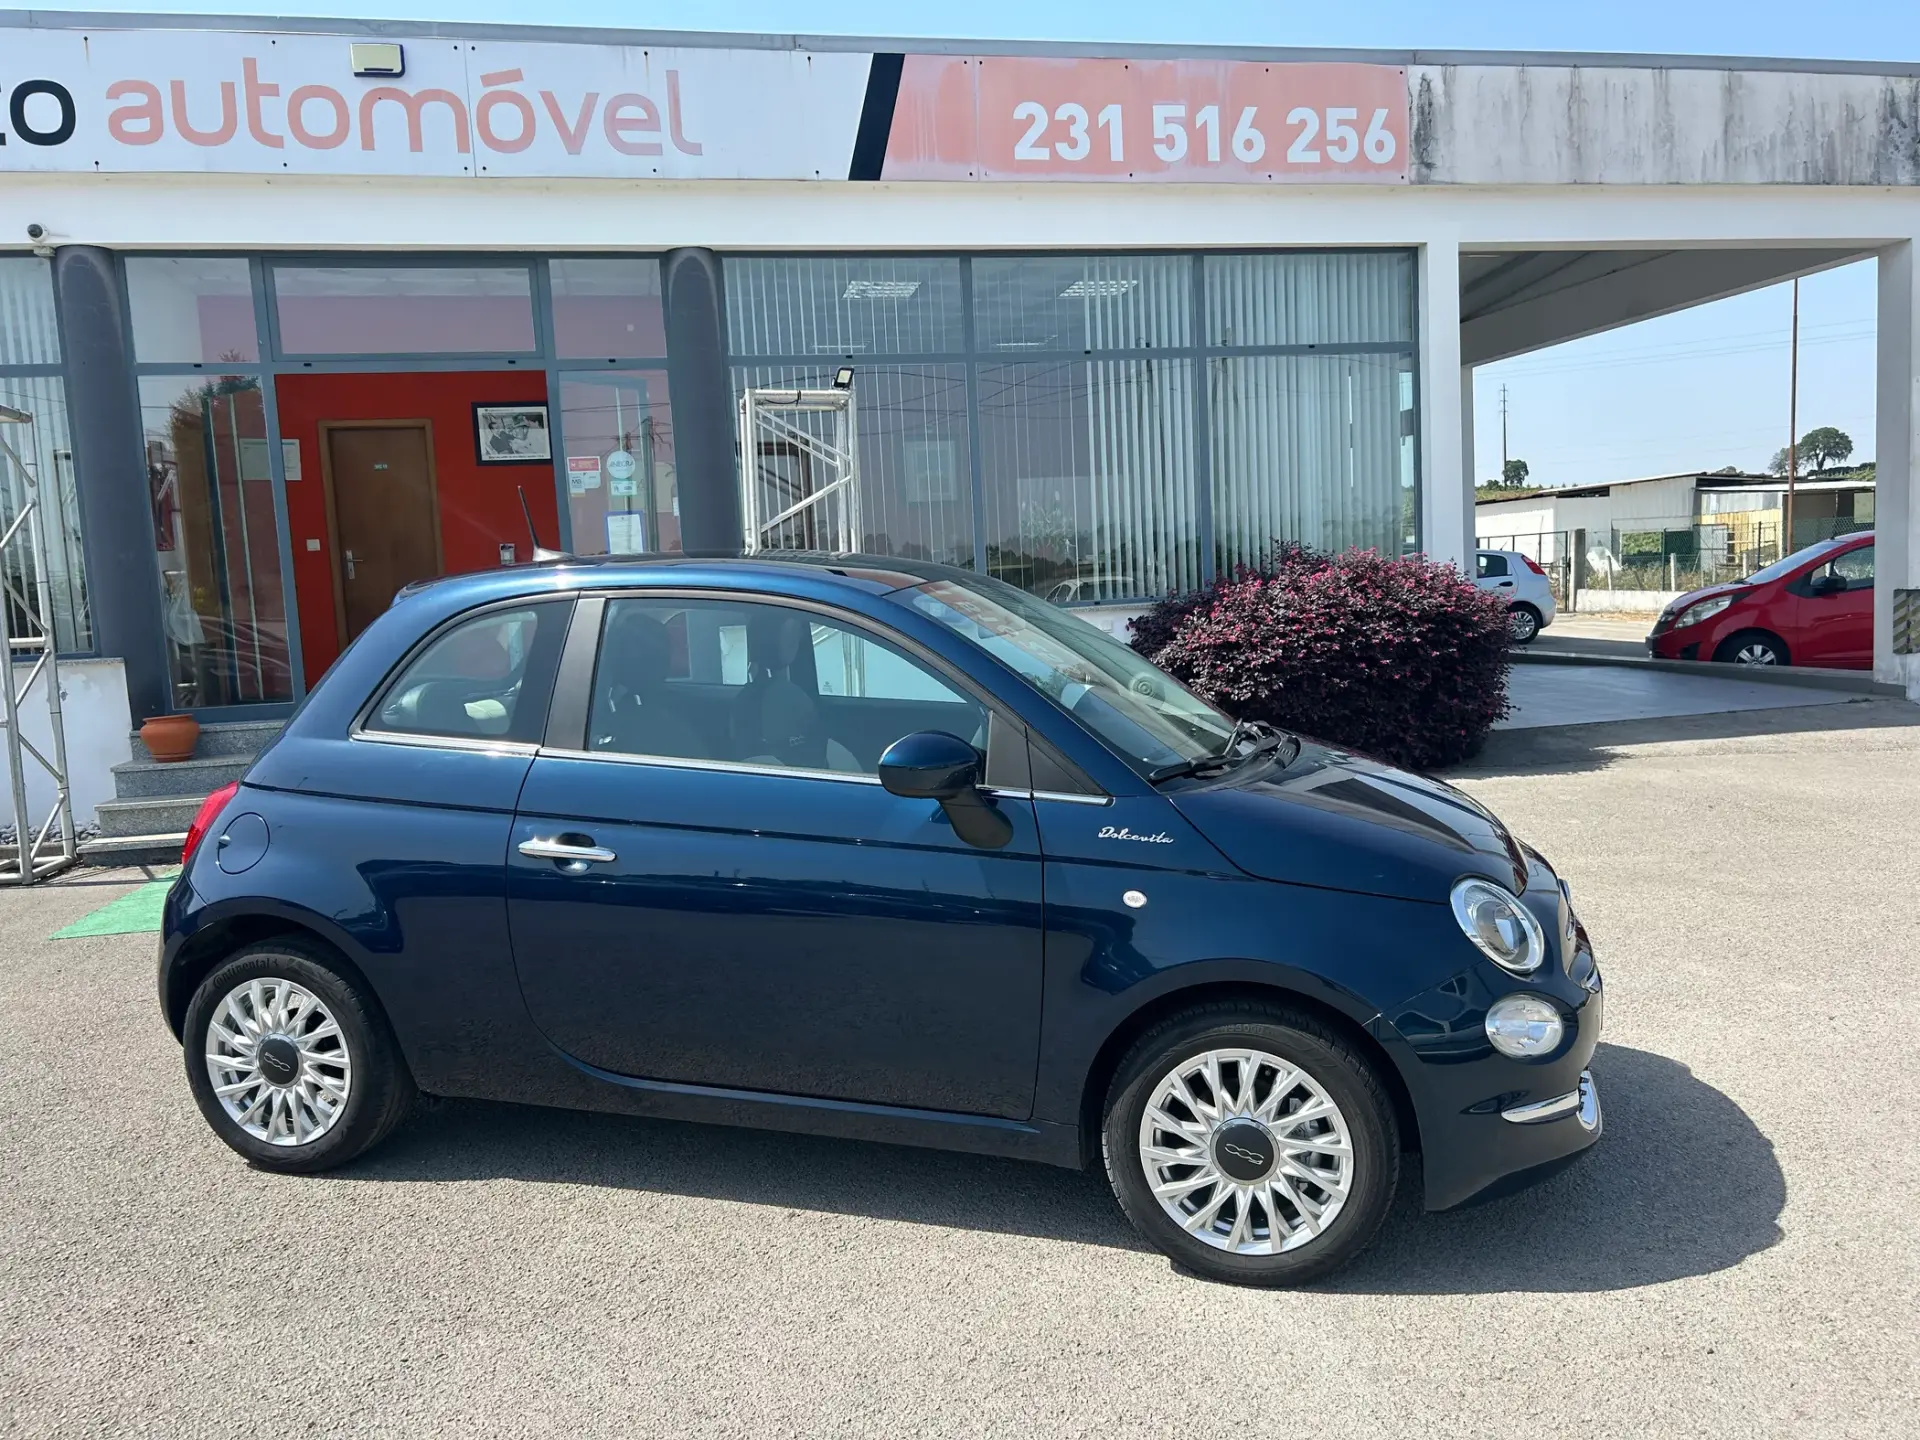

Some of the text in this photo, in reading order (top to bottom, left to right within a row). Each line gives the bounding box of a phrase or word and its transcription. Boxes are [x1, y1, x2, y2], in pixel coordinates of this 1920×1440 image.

[0, 57, 703, 156] o automóvel
[1013, 102, 1396, 164] 231 516 256
[1098, 826, 1174, 843] Dolcevita
[213, 958, 270, 988] Continental
